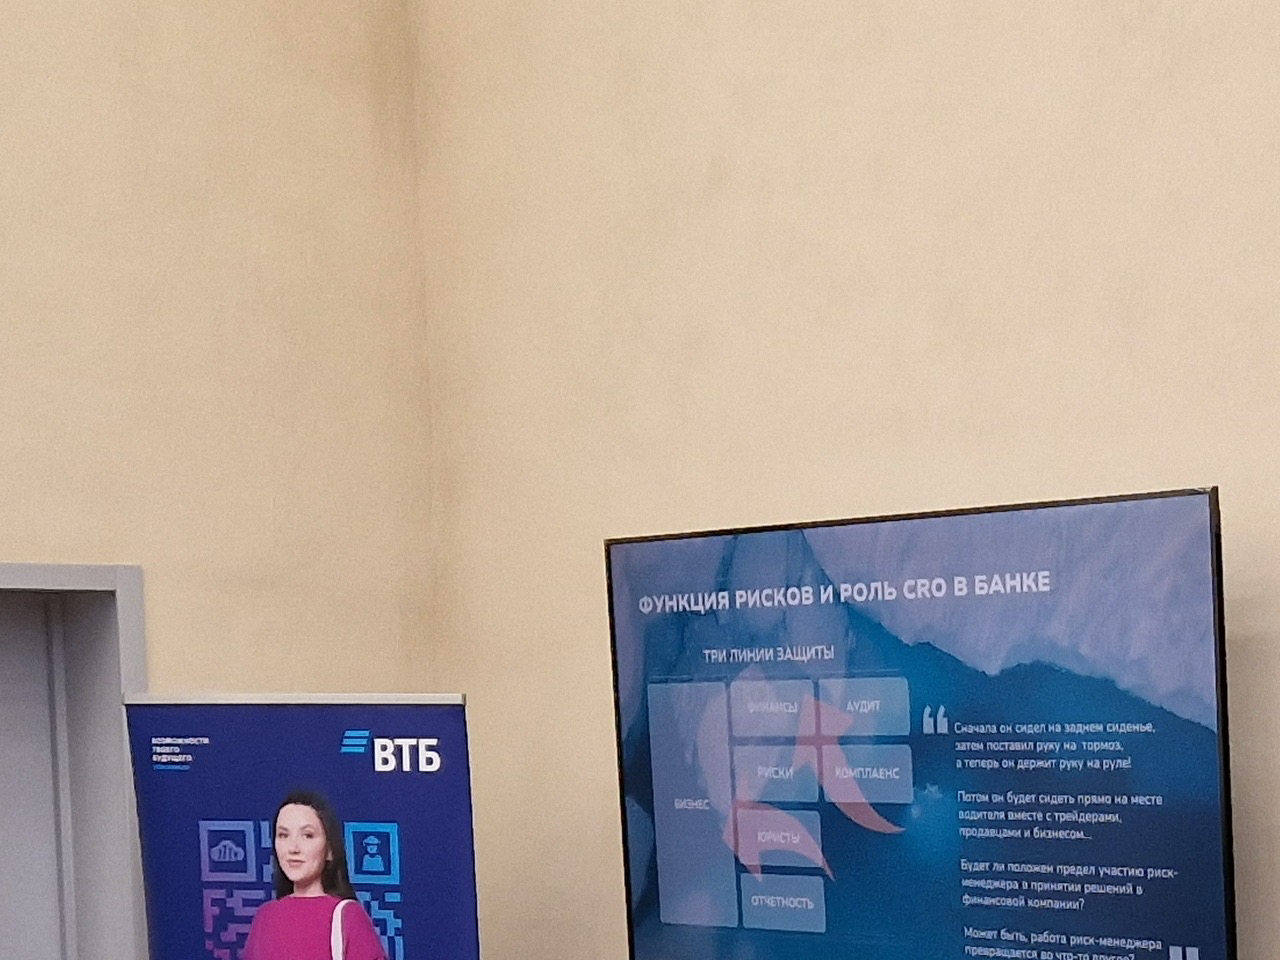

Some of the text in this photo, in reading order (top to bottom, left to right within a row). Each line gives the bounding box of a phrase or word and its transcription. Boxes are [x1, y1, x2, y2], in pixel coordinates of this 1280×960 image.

[639, 590, 730, 615] ФУНКЦИЯ
[735, 585, 814, 609] РИСКОВ
[820, 584, 834, 604] И
[840, 581, 897, 603] РОЛЬ
[953, 576, 968, 596] В
[974, 571, 1051, 595] БАНКЕ
[703, 645, 835, 664] ТРИ ЛИНИИ ЗАЩИТЫ
[846, 700, 881, 714] АУДИТ
[954, 722, 997, 734] Сначала
[999, 723, 1013, 734] он
[1015, 723, 1046, 735] сидел
[1049, 723, 1062, 733] на
[1064, 723, 1103, 735] заднем
[986, 740, 1034, 752] поставил
[1036, 741, 1061, 754] руку
[1063, 741, 1077, 751] на
[374, 738, 441, 772] ВТБ
[964, 759, 999, 771] теперь
[1001, 759, 1015, 769] он
[1059, 759, 1084, 772] руку
[1086, 760, 1100, 769] на
[756, 766, 794, 780] РИСКИ
[834, 766, 900, 780] КОМПЛАЕНС
[1006, 791, 1037, 804] будет
[757, 831, 801, 844] ЮРИСТЫ
[1056, 863, 1096, 876] предел
[751, 895, 815, 910] ОТЧЕТНОСТЬ
